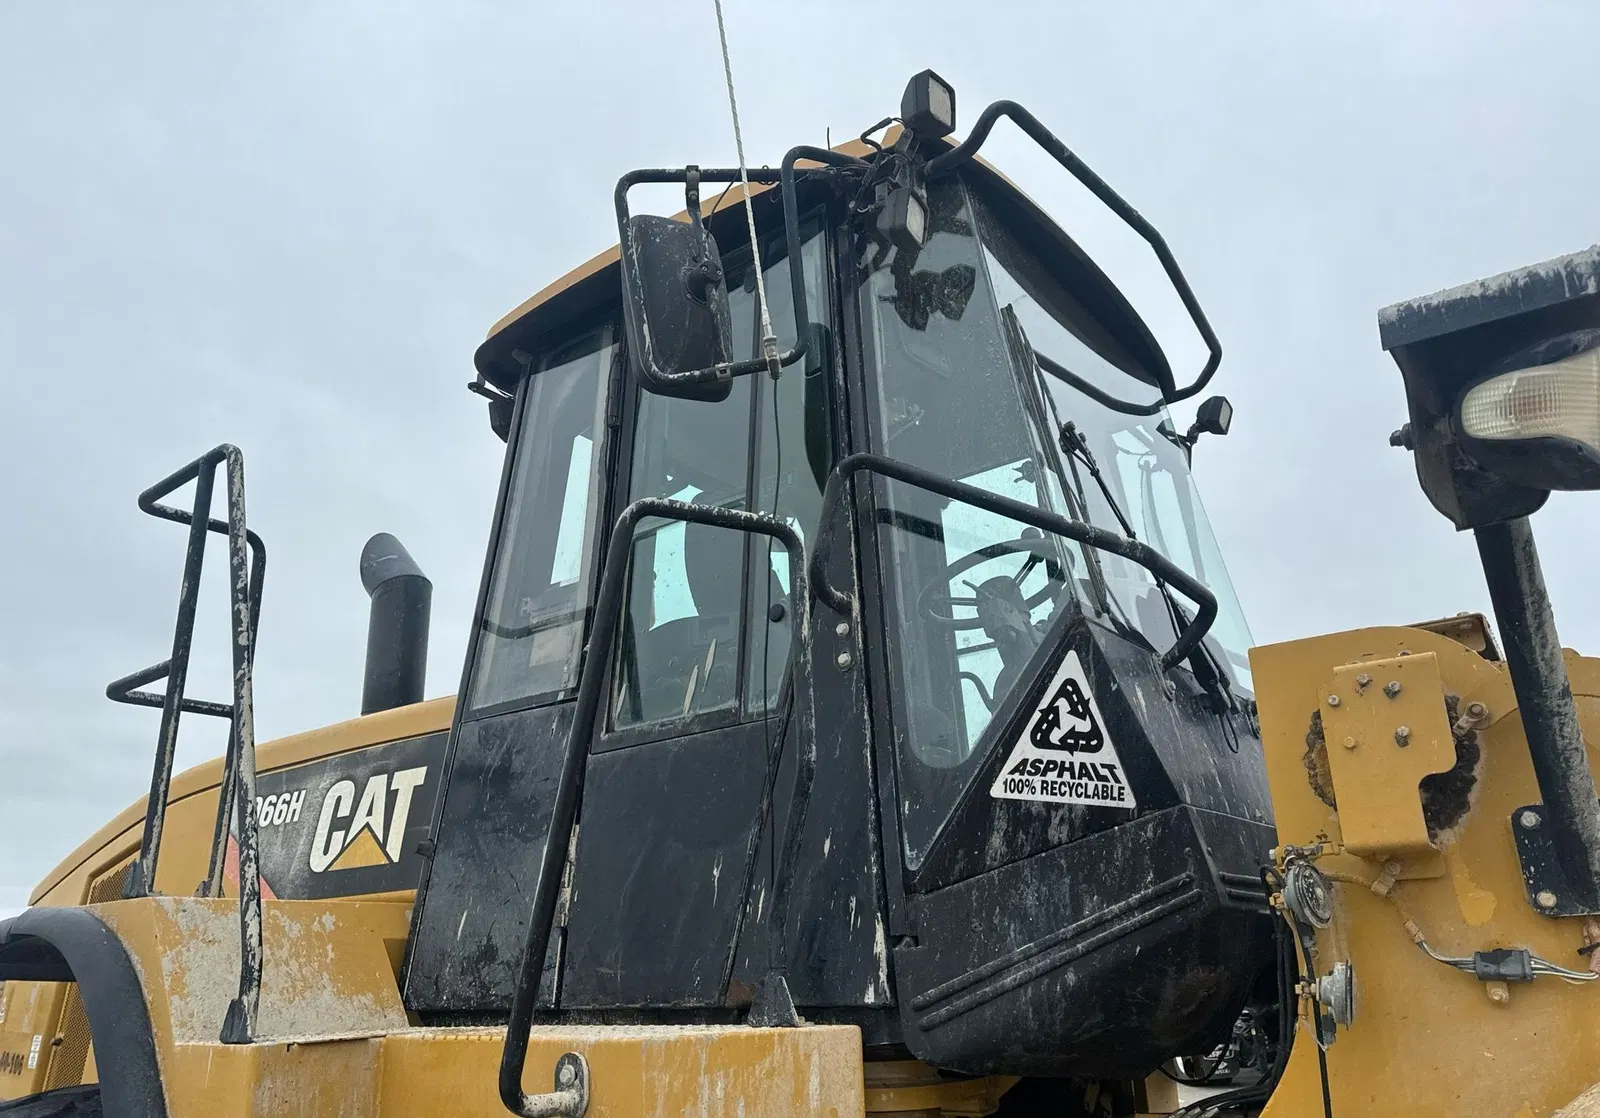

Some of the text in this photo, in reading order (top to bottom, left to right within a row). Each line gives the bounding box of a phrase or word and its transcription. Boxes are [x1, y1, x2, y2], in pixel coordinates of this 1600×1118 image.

[1007, 758, 1122, 784] ASPHALT
[1002, 778, 1126, 802] 100% RECYCLABLE
[309, 766, 428, 873] CAT
